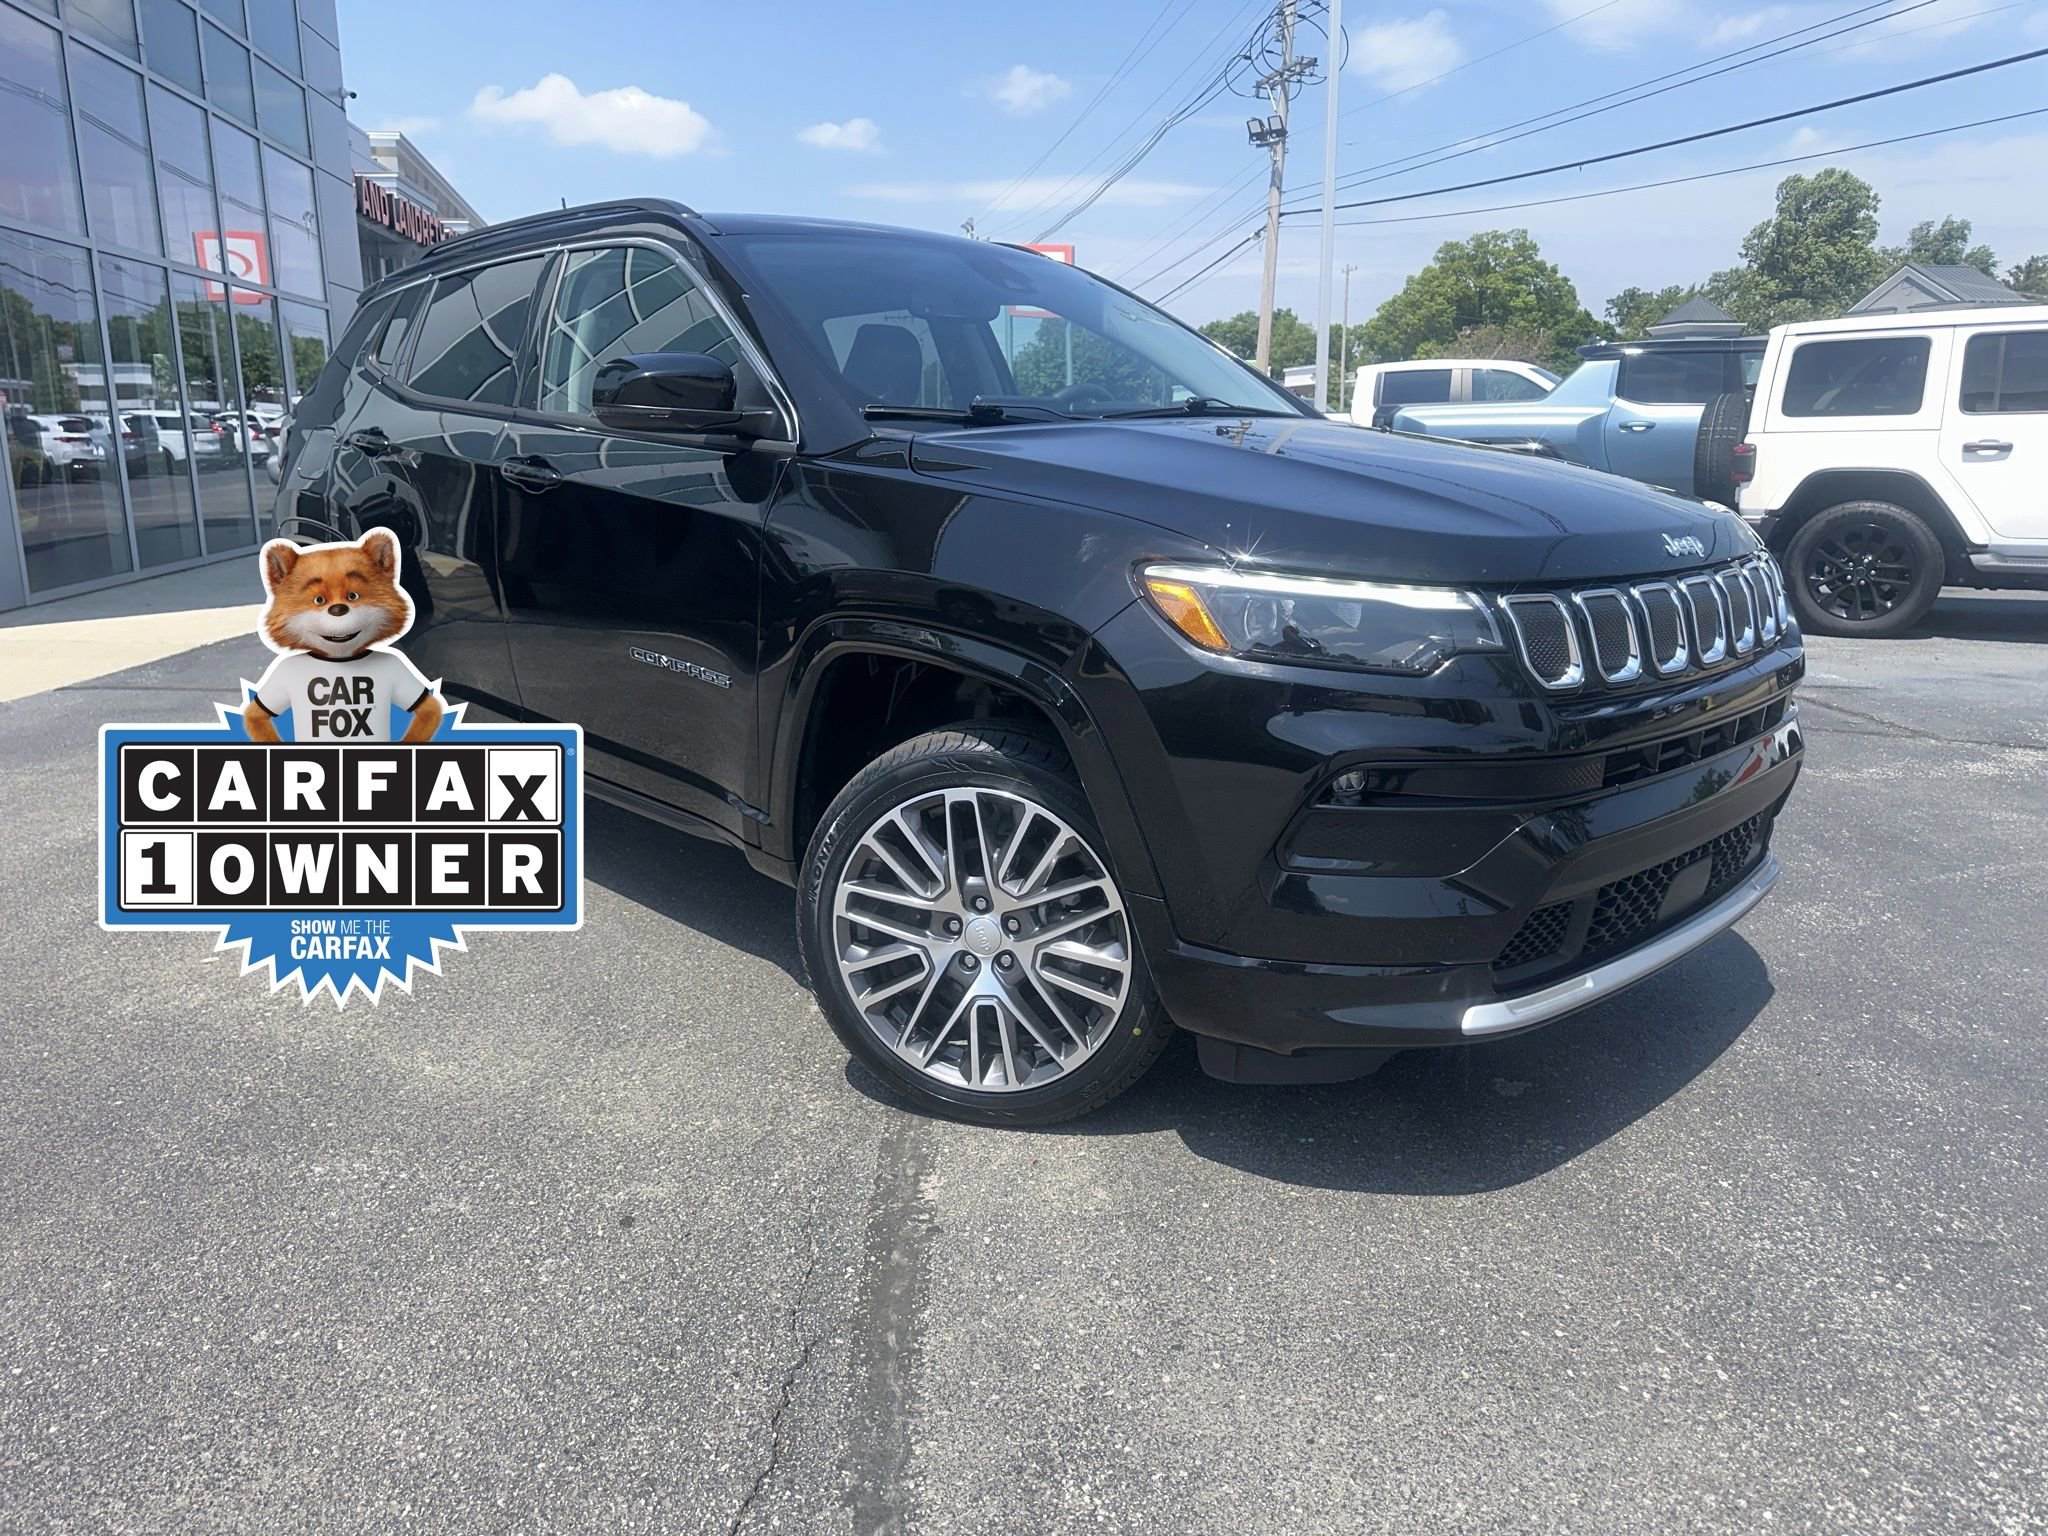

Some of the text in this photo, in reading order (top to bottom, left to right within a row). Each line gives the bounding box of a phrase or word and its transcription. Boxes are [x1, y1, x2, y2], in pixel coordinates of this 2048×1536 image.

[363, 176, 390, 227] AND
[1661, 533, 1705, 558] Jeep
[629, 646, 732, 689] COMPASS
